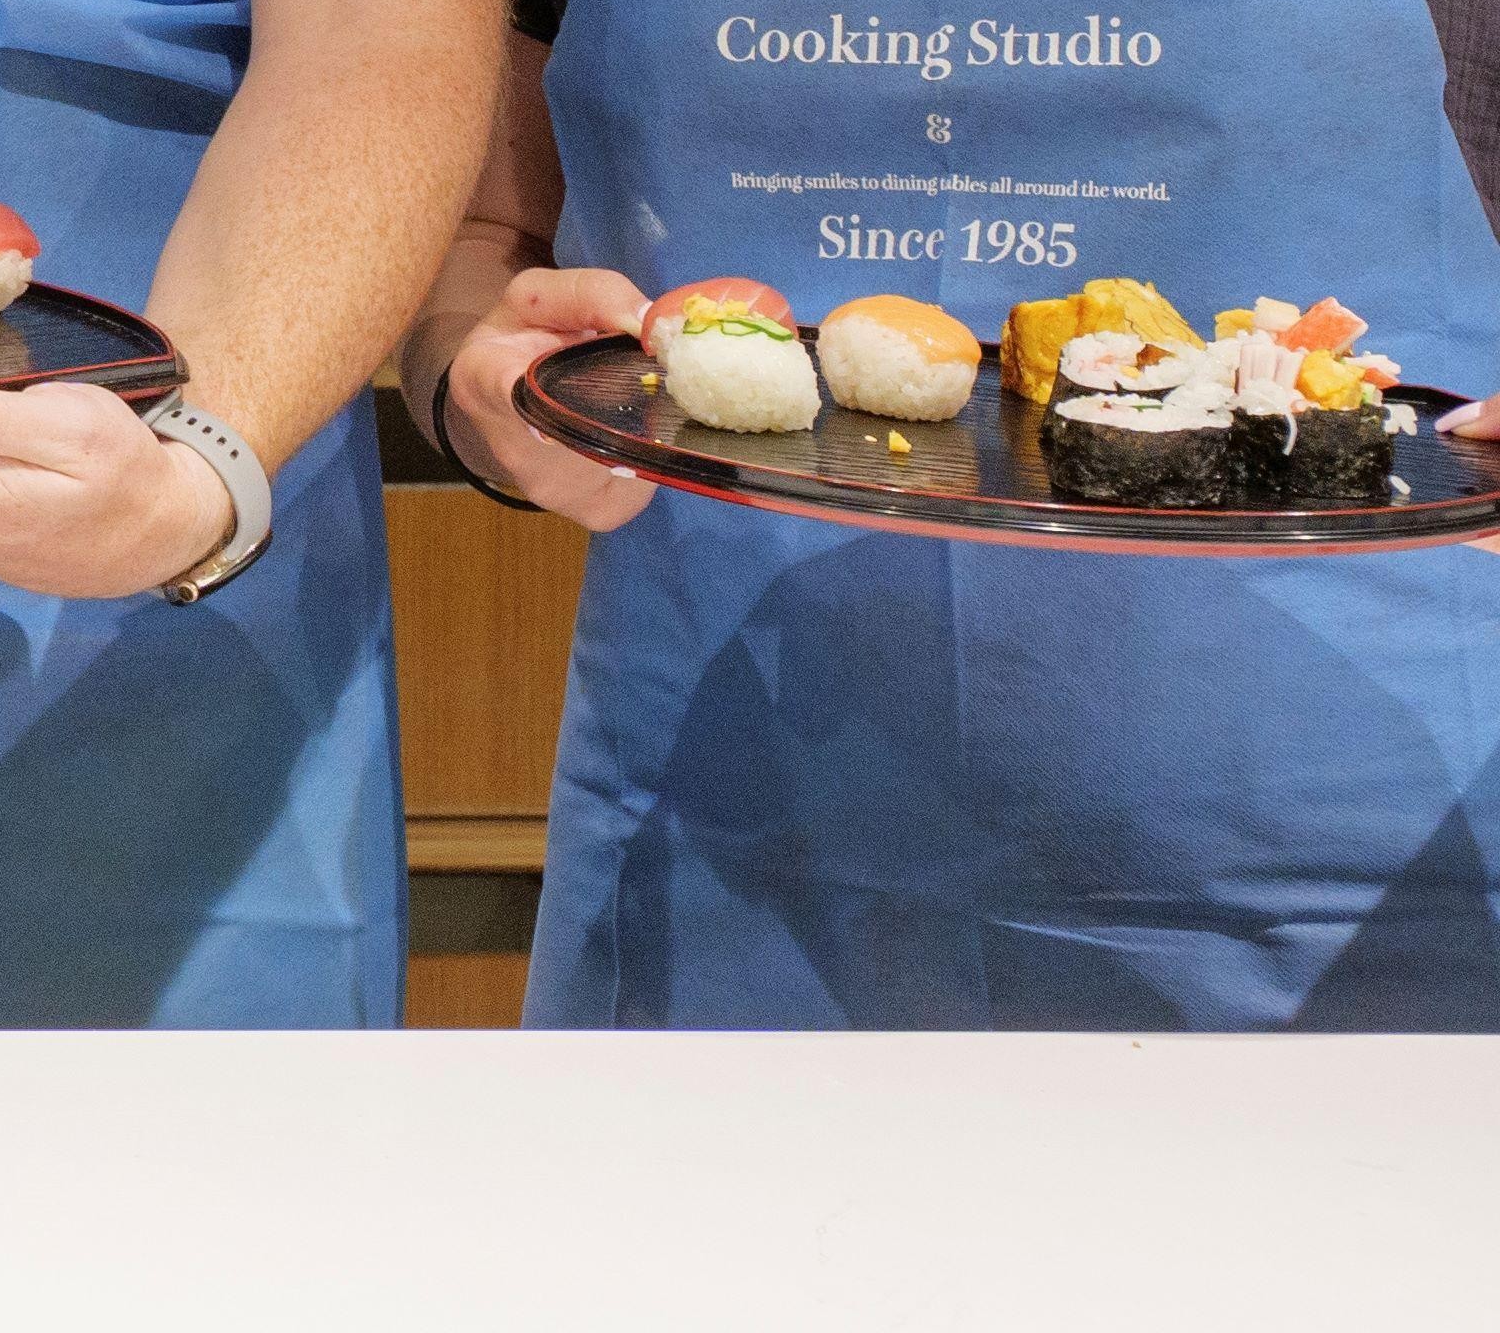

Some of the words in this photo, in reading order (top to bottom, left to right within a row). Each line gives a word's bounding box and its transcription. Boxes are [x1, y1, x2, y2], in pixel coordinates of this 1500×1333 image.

[716, 14, 954, 81] Cooking
[967, 16, 1162, 67] Studio
[926, 114, 952, 144] &
[731, 172, 802, 193] Bringing
[804, 174, 859, 190] smiles
[861, 176, 880, 190] to
[882, 173, 938, 196] dining
[991, 176, 1012, 193] all
[1015, 180, 1078, 197] around
[1081, 181, 1108, 198] the
[1112, 184, 1171, 201] world.
[818, 214, 945, 261] Since
[959, 220, 1078, 268] 1985
